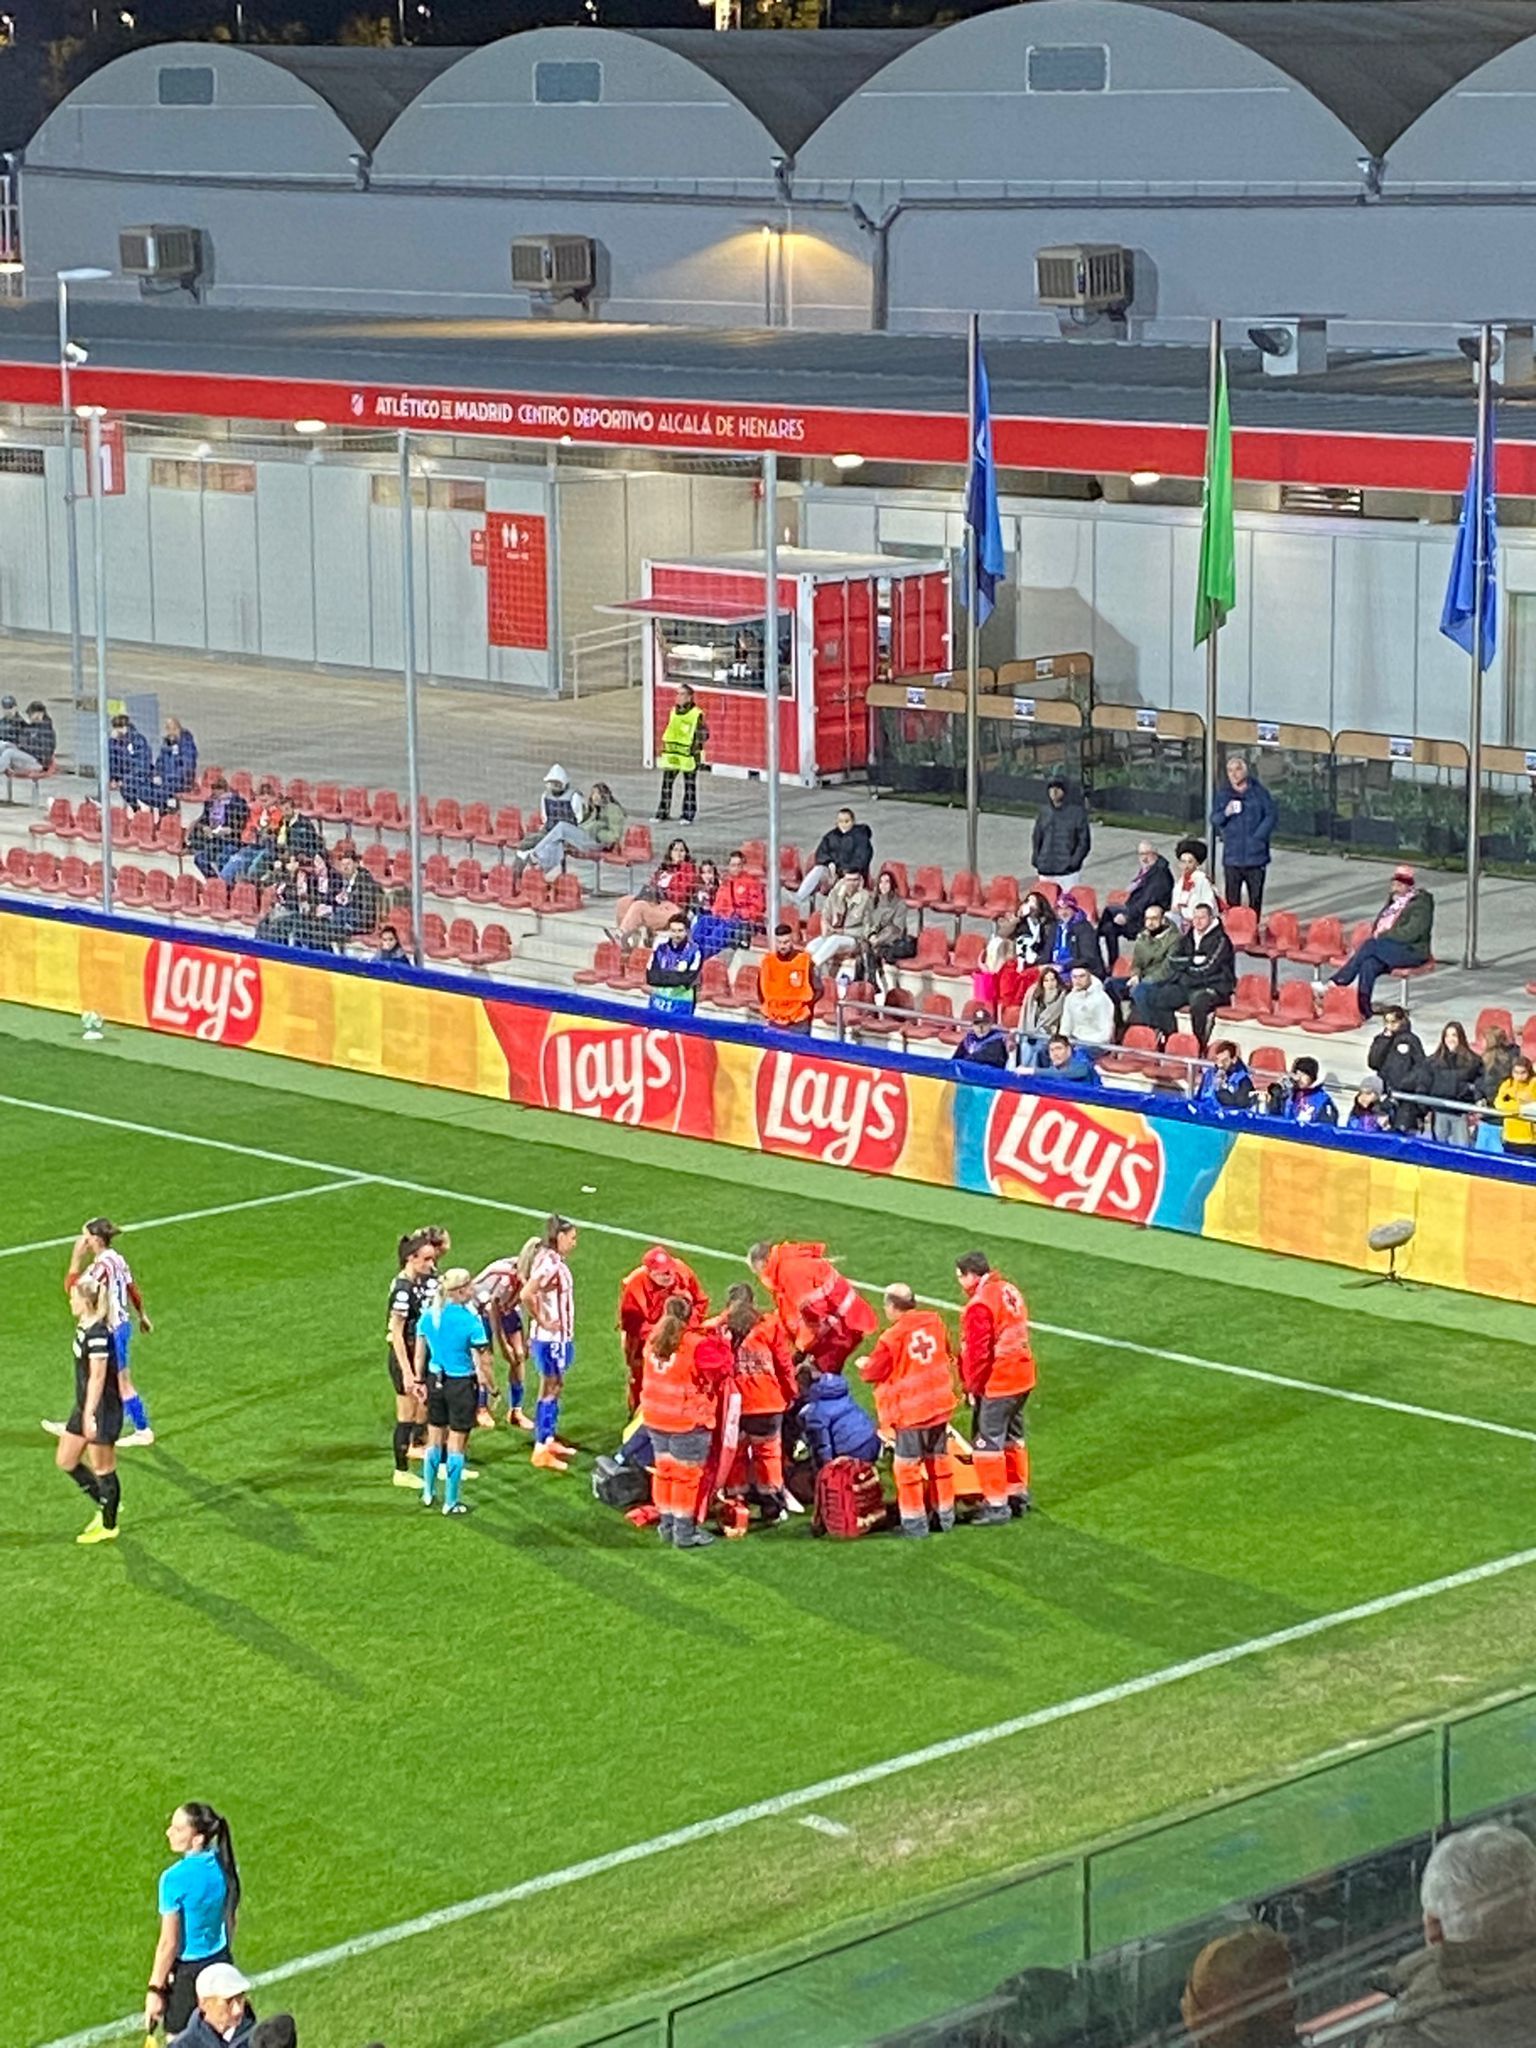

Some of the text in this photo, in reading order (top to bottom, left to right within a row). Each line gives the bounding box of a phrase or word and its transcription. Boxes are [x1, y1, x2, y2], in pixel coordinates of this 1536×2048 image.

[375, 393, 440, 419] ATLÉTICO
[454, 401, 513, 423] MADRID
[518, 404, 571, 425] CENTRO
[573, 406, 653, 432] DEPORTIVO
[658, 411, 713, 436] ALCALÁ
[716, 415, 736, 437] DE
[739, 416, 805, 441] HENARES
[151, 939, 257, 1042] Lay's
[763, 1050, 900, 1167] Lay's
[994, 1094, 1153, 1213] Lay's
